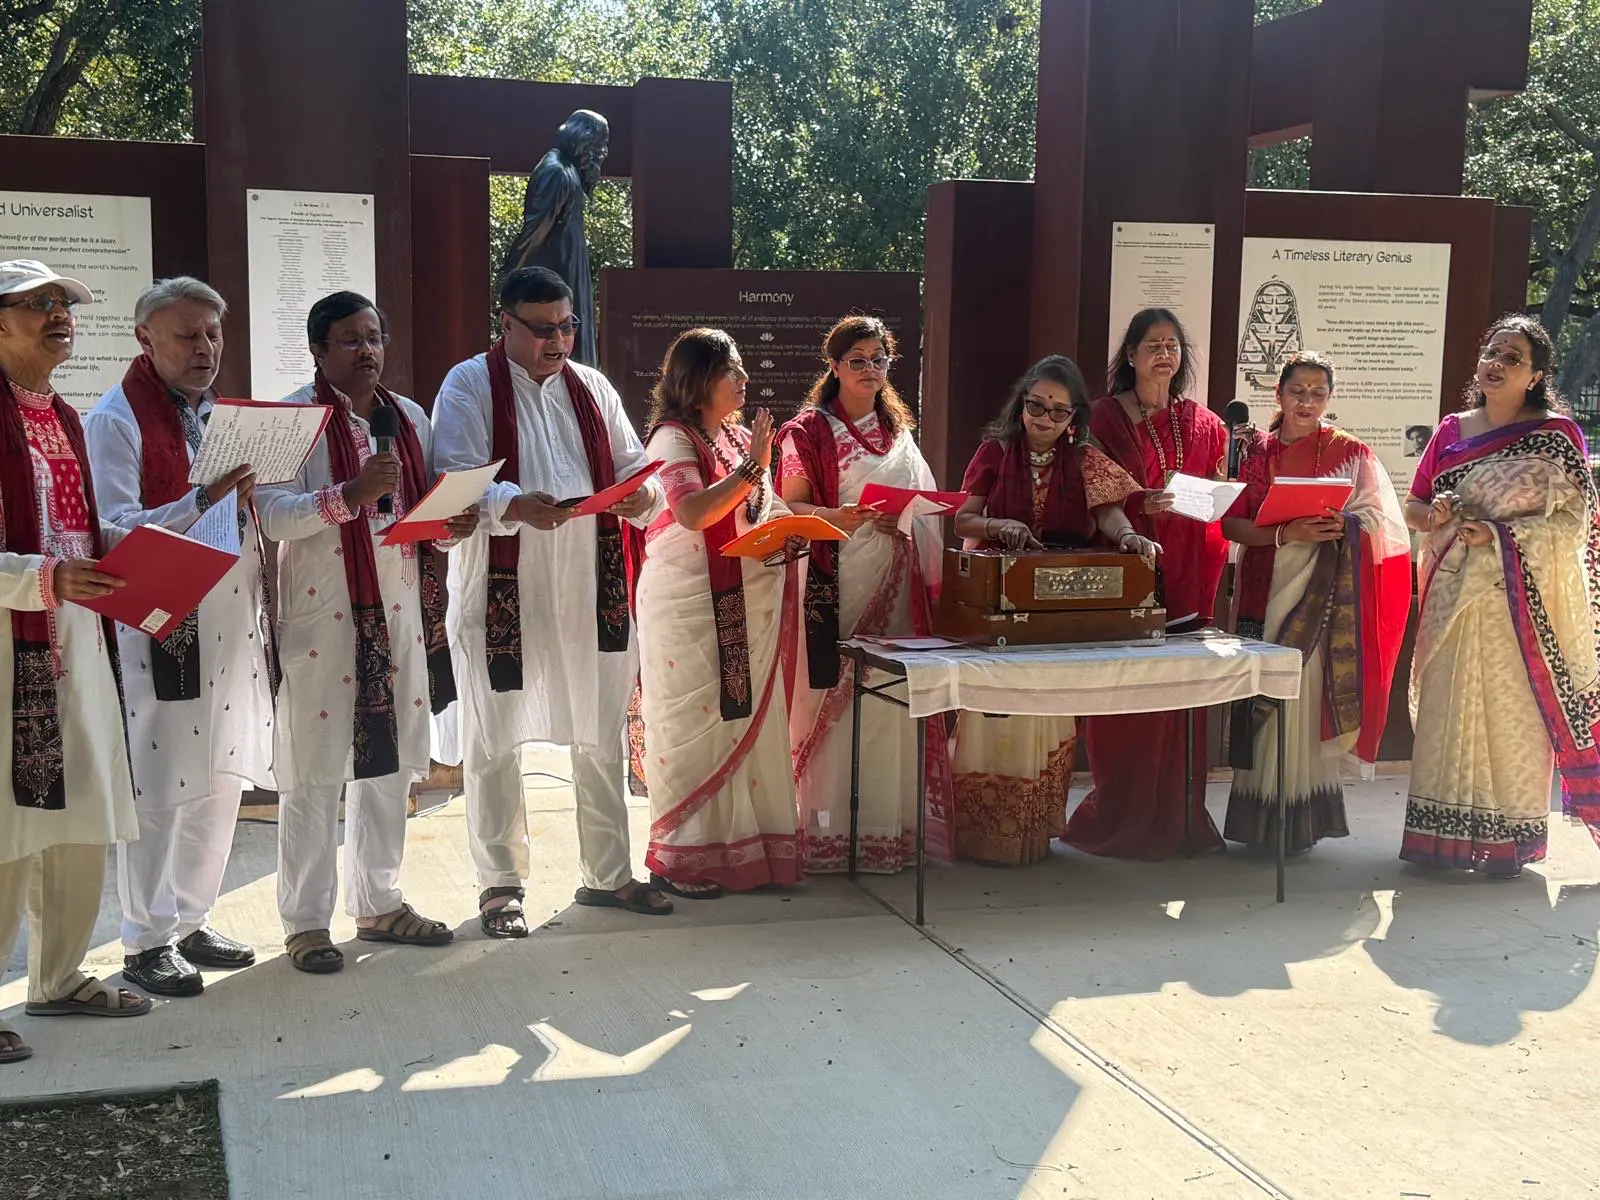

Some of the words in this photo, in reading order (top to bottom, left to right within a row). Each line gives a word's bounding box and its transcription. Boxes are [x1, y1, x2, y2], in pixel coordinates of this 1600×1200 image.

[11, 202, 94, 218] Universalist
[1272, 249, 1281, 260] A
[1284, 249, 1330, 261] Timeless
[1333, 250, 1374, 265] Literary
[1376, 251, 1412, 263] Genius
[740, 290, 794, 306] Harmony
